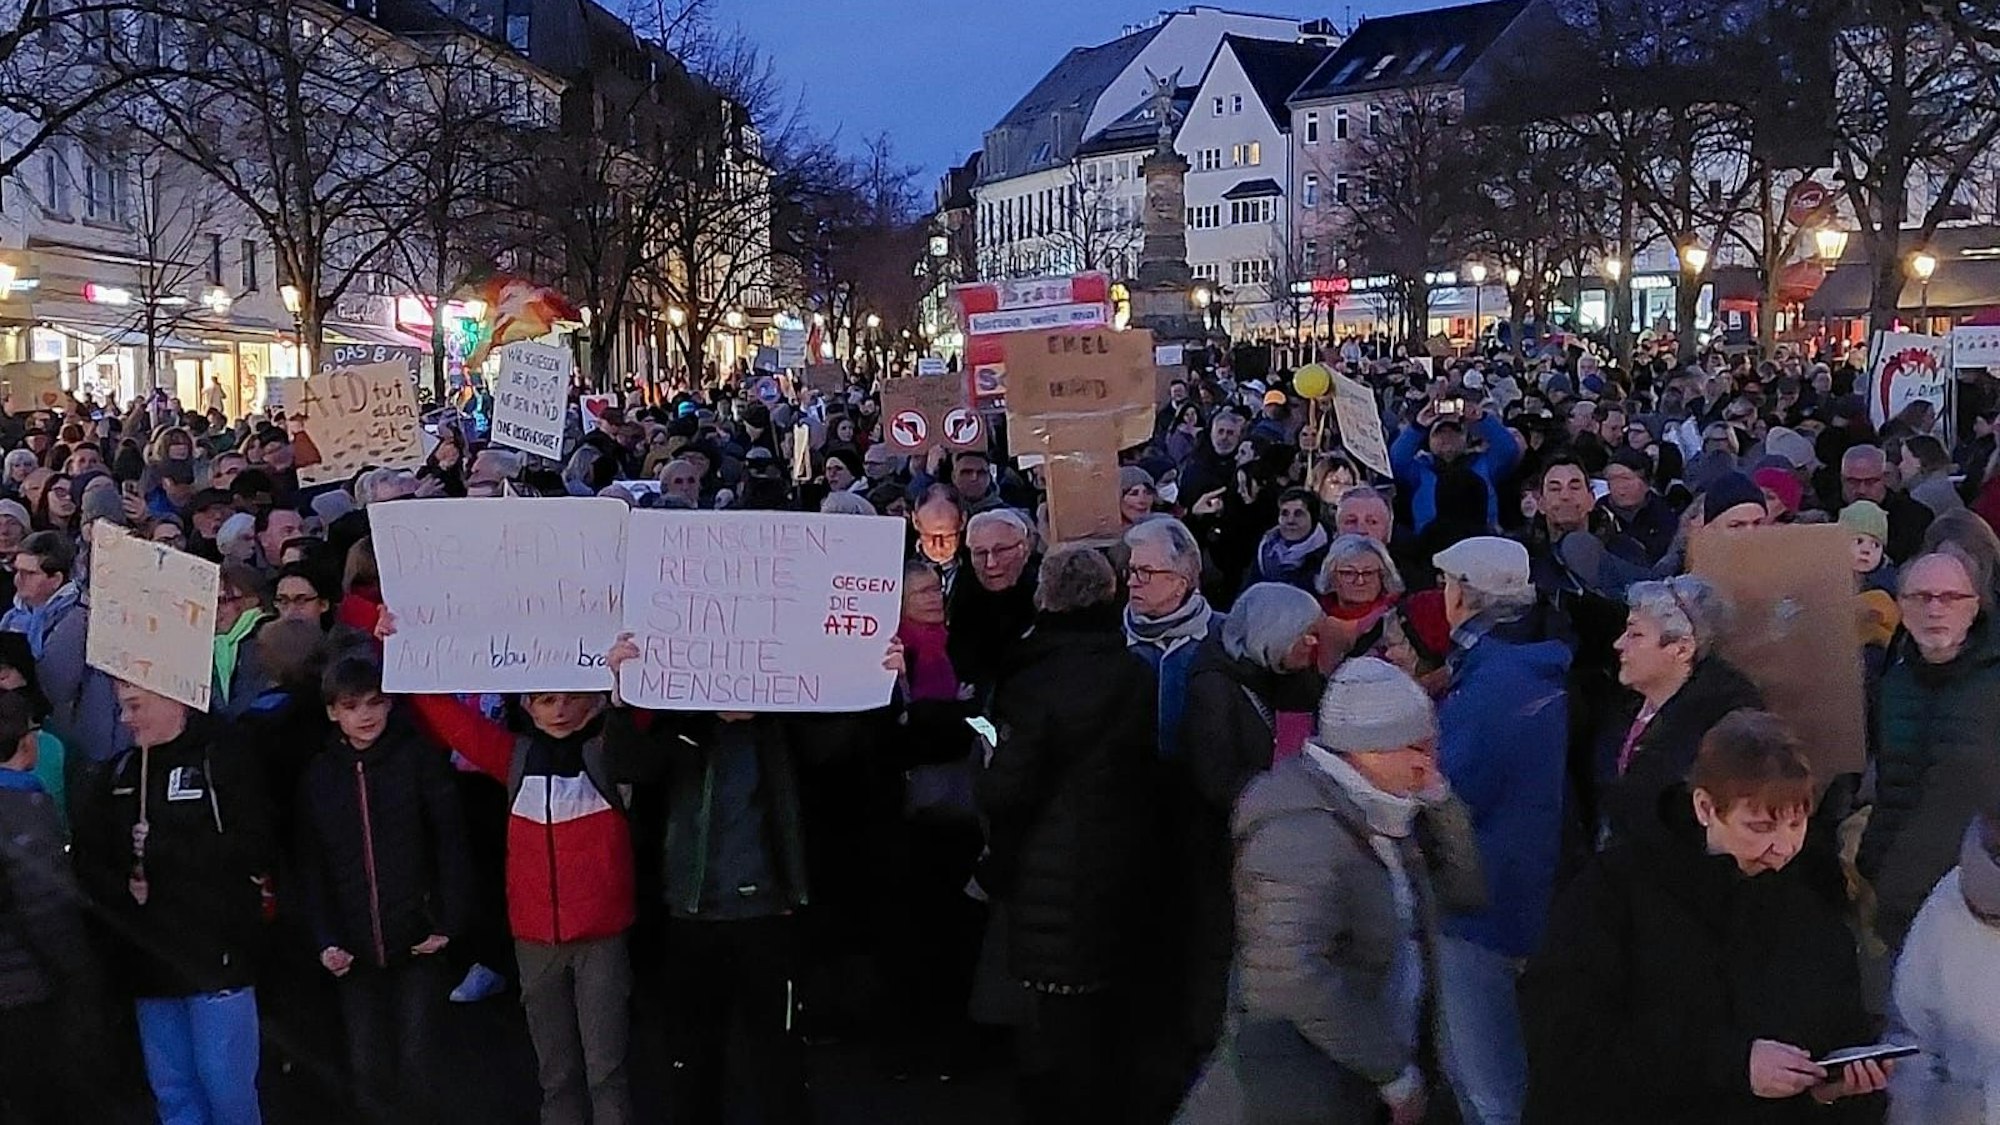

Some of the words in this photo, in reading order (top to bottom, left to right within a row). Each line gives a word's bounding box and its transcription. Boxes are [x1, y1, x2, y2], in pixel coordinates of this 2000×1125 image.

[335, 345, 367, 363] DAS
[1047, 335, 1109, 355] EKEL
[372, 380, 403, 400] tut
[371, 404, 415, 418] allen
[662, 524, 845, 555] MENSCHEN-
[660, 556, 798, 588] RECHTE
[832, 575, 896, 592] GEGEN
[829, 595, 859, 611] DIE
[648, 591, 799, 636] STATT
[645, 636, 783, 673] RECHTE
[639, 671, 820, 704] MENSCHEN
